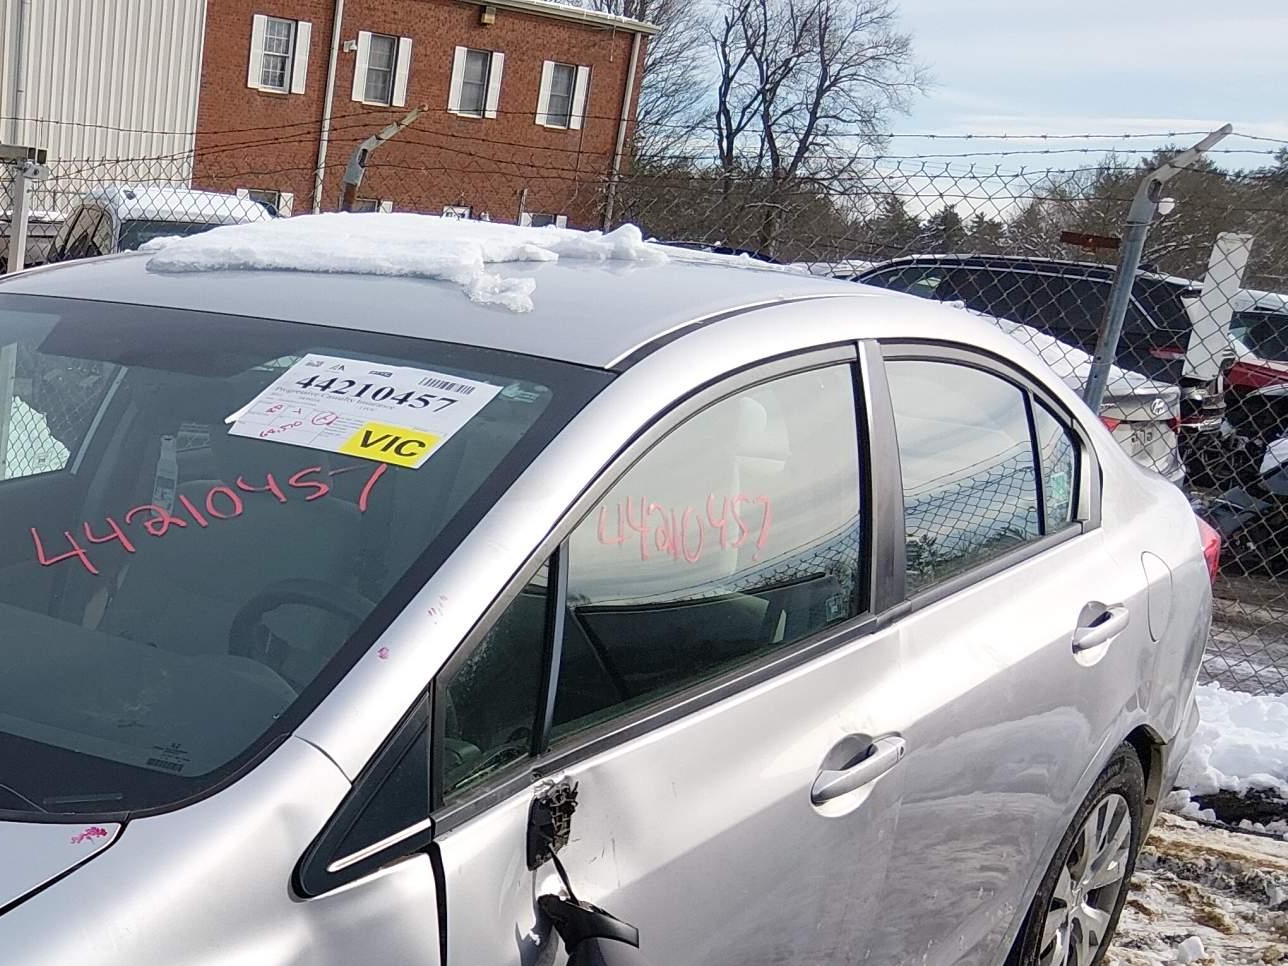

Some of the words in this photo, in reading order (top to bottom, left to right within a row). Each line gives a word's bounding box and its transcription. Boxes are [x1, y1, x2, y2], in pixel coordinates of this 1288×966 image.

[296, 374, 458, 413] 44210457
[360, 430, 426, 457] VIC
[31, 464, 387, 575] 44210457
[597, 494, 773, 563] 44210457
